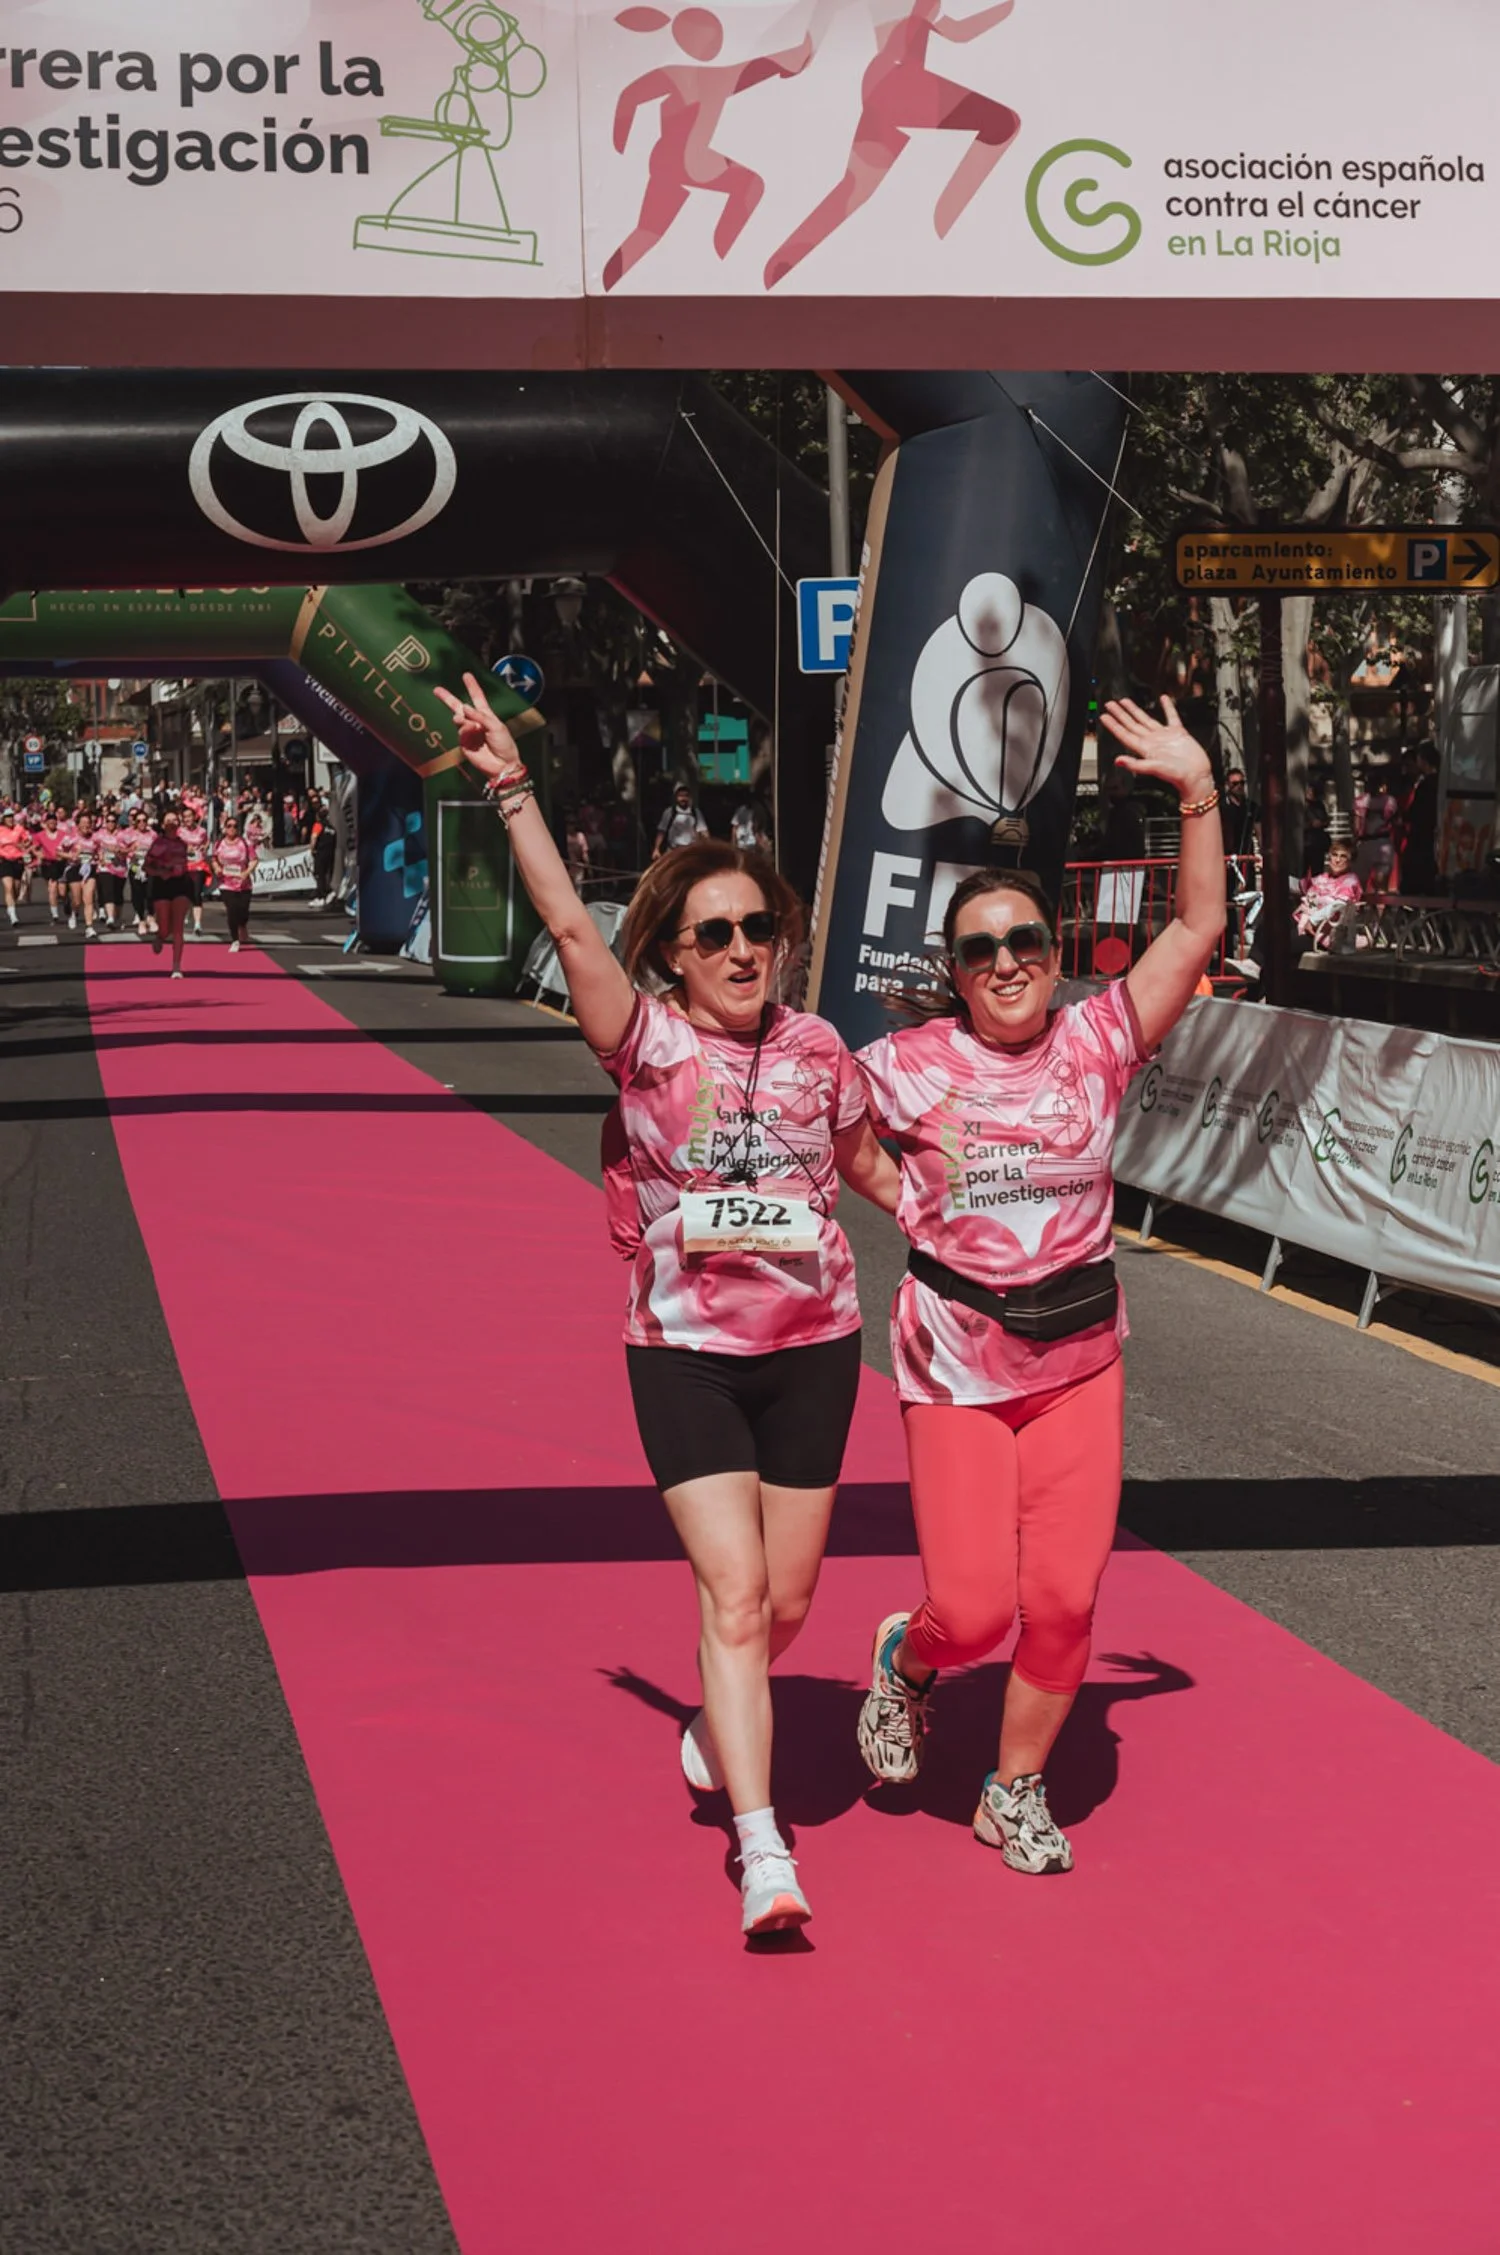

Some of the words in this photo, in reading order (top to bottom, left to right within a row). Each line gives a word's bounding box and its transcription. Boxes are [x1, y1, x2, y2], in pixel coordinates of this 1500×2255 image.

[0, 47, 157, 92] rera
[179, 51, 301, 107] por
[319, 40, 384, 97] la
[0, 113, 370, 186] estigación
[1164, 152, 1333, 180] asociación
[1342, 154, 1485, 188] española
[1166, 192, 1268, 217] contra
[1278, 190, 1304, 218] el
[1313, 191, 1422, 219] cáncer
[1167, 234, 1207, 256] en
[1216, 229, 1253, 256] La
[1263, 230, 1341, 264] Rioja
[1183, 563, 1238, 584] plaza
[1251, 563, 1398, 583] Ayuntamiento
[1413, 543, 1440, 578] P
[817, 589, 857, 661] P
[317, 621, 443, 749] PITILLOS
[688, 1076, 717, 1165] mujer
[962, 1121, 981, 1136] XI
[963, 1141, 1041, 1160] Carrera
[965, 1168, 999, 1188] por
[1003, 1164, 1024, 1181] la
[969, 1178, 1095, 1209] Investigación
[705, 1197, 792, 1229] 7522
